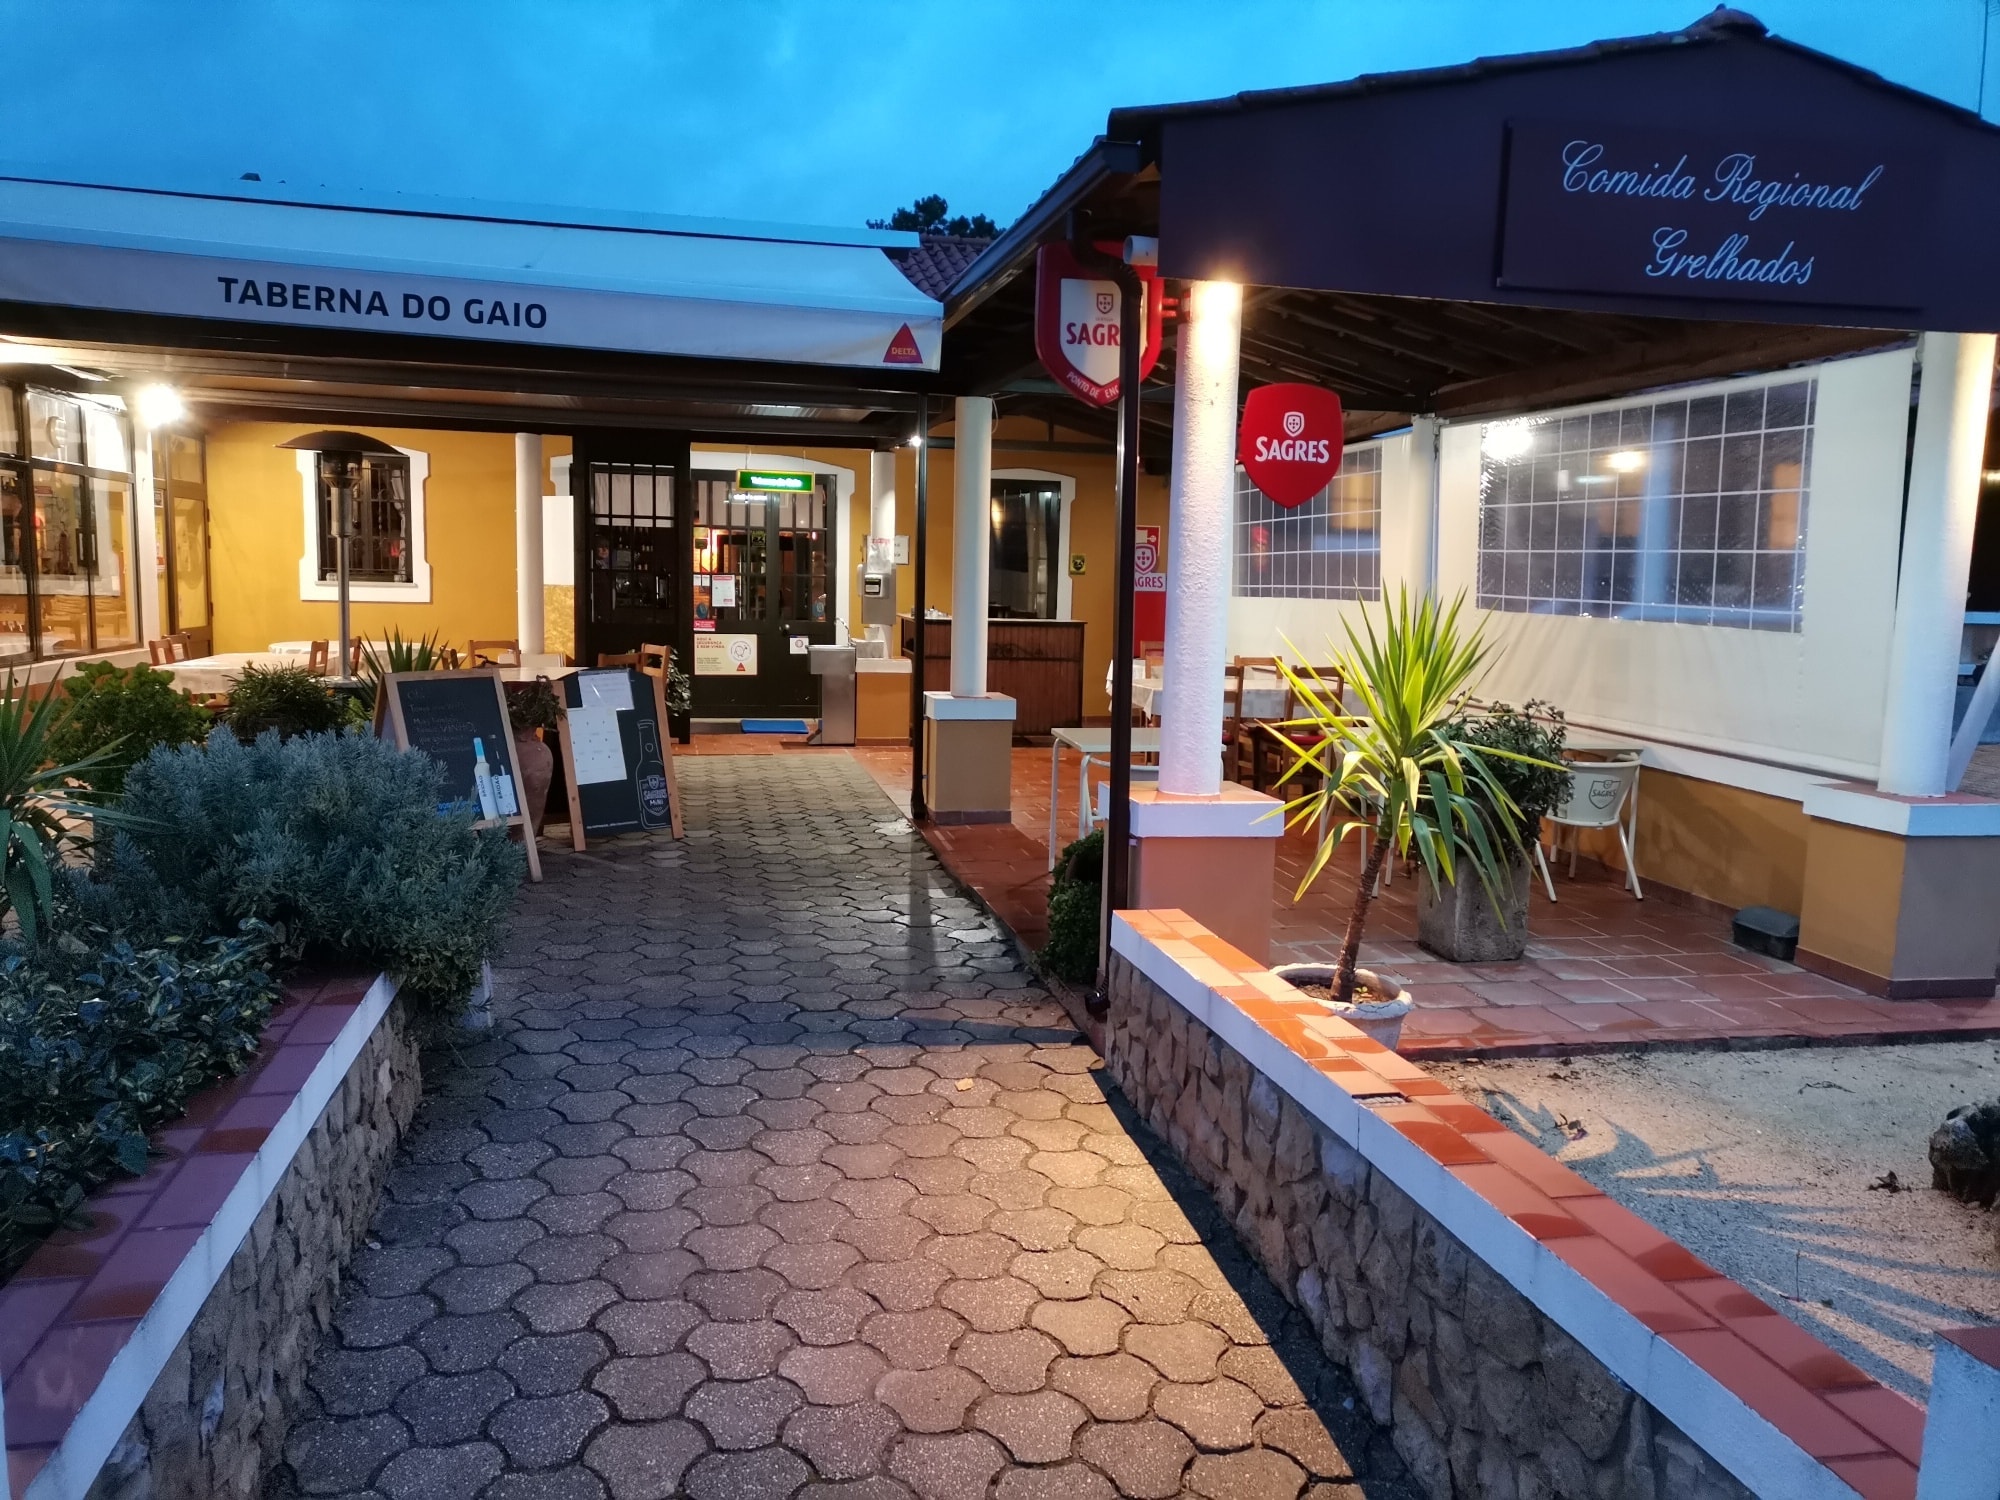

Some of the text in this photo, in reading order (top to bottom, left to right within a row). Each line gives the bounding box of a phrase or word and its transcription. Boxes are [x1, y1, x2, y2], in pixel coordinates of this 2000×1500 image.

[1562, 139, 1885, 222] Comida Regional
[1645, 226, 1815, 286] Grelhados
[217, 276, 547, 329] TABERNA DO GAIO
[1066, 322, 1120, 347] SAGR
[891, 347, 917, 356] DELTA
[1066, 371, 1090, 393] PONTO
[1089, 387, 1099, 398] DE
[1254, 436, 1330, 464] SAGRES
